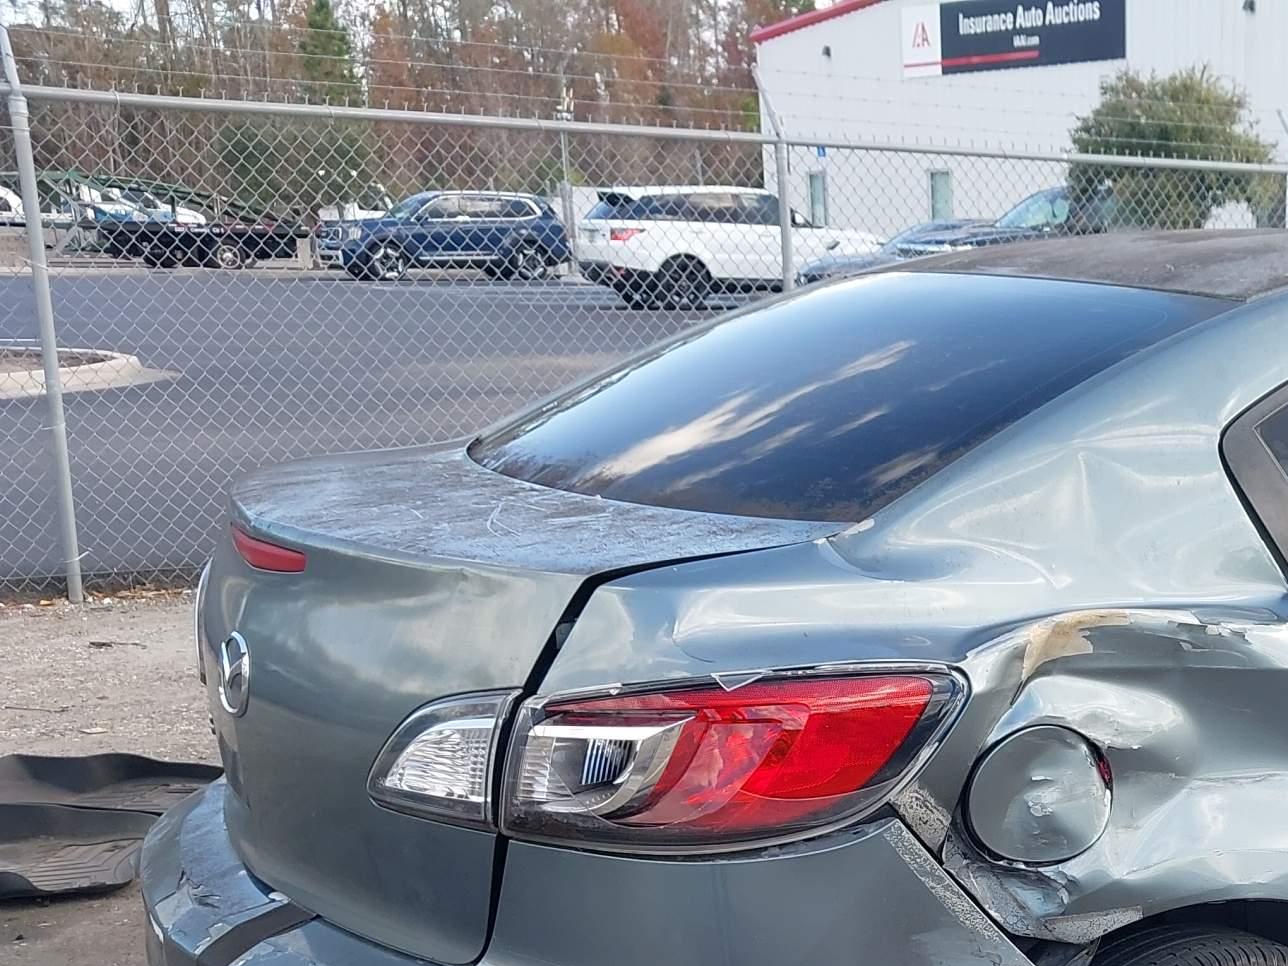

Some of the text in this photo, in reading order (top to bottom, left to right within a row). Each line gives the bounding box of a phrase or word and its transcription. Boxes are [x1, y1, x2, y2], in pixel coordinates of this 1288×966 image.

[958, 0, 1101, 36] Insurance Auto Auctions
